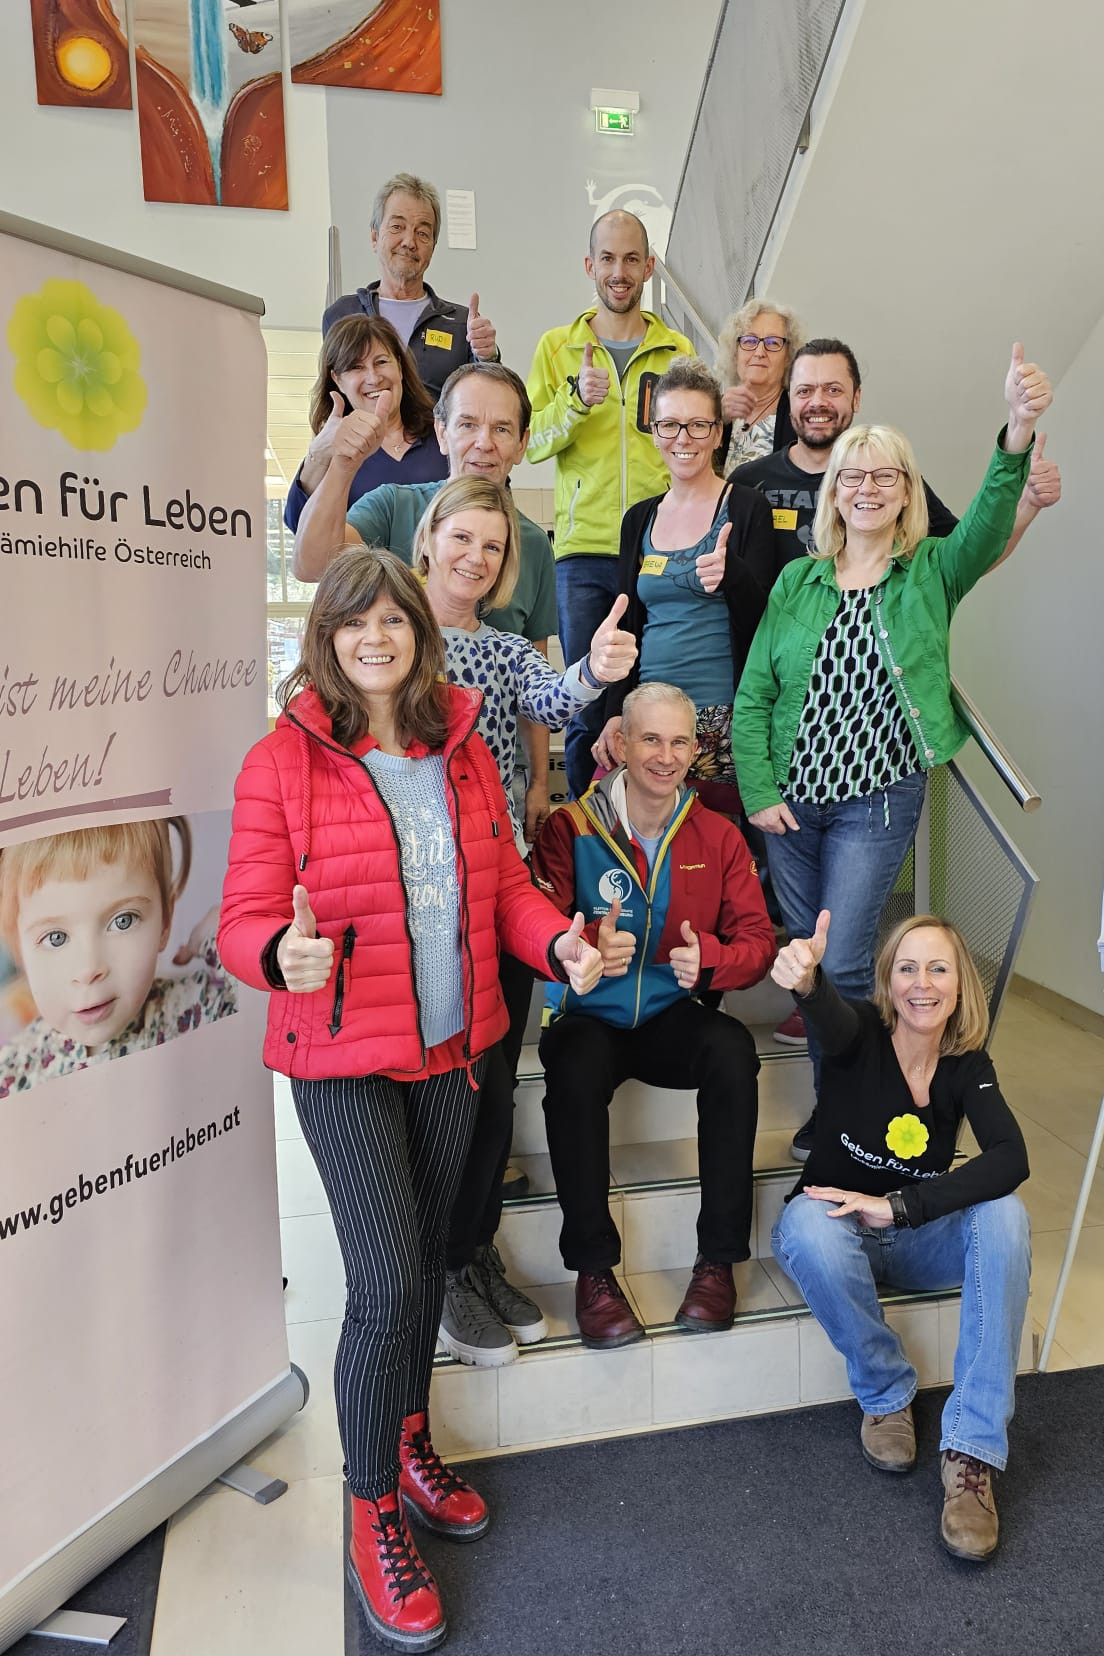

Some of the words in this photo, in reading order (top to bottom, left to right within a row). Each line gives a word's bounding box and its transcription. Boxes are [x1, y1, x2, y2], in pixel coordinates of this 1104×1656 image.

[60, 472, 128, 522] für
[143, 485, 252, 538] Leben
[0, 532, 106, 561] ämiehilfe
[115, 538, 212, 569] Österreich
[49, 656, 153, 711] meine
[163, 650, 257, 697] Chance
[0, 732, 117, 801] Leben!
[429, 827, 455, 866] it
[840, 1132, 883, 1165] Geben
[885, 1158, 911, 1172] für
